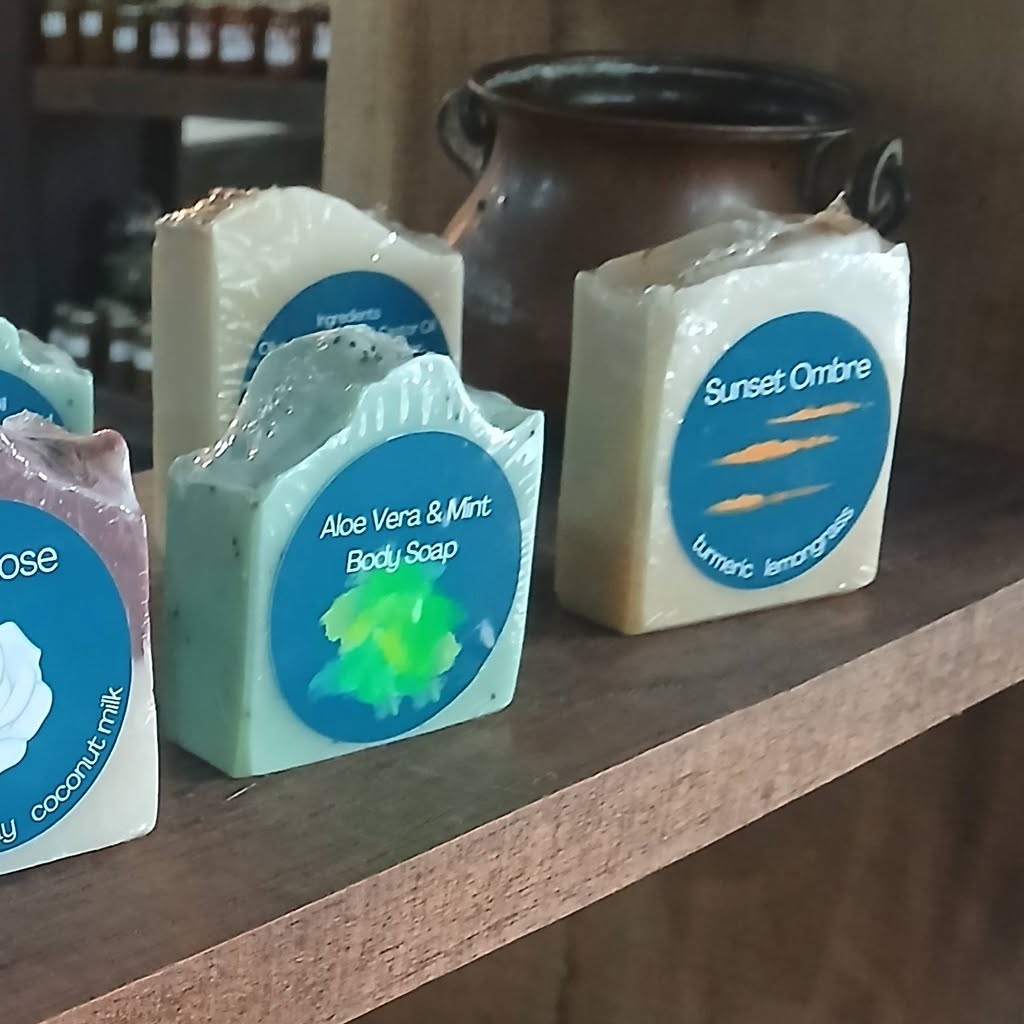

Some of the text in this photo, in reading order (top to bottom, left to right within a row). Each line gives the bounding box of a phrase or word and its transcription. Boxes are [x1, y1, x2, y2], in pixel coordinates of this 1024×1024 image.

[703, 356, 872, 407] Sunset Ombre
[319, 494, 493, 540] Aloe Vera & Mint
[691, 505, 855, 579] turmeric lemongrass
[345, 539, 459, 574] Body Soap
[30, 736, 106, 823] coconut
[97, 685, 124, 737] milk
